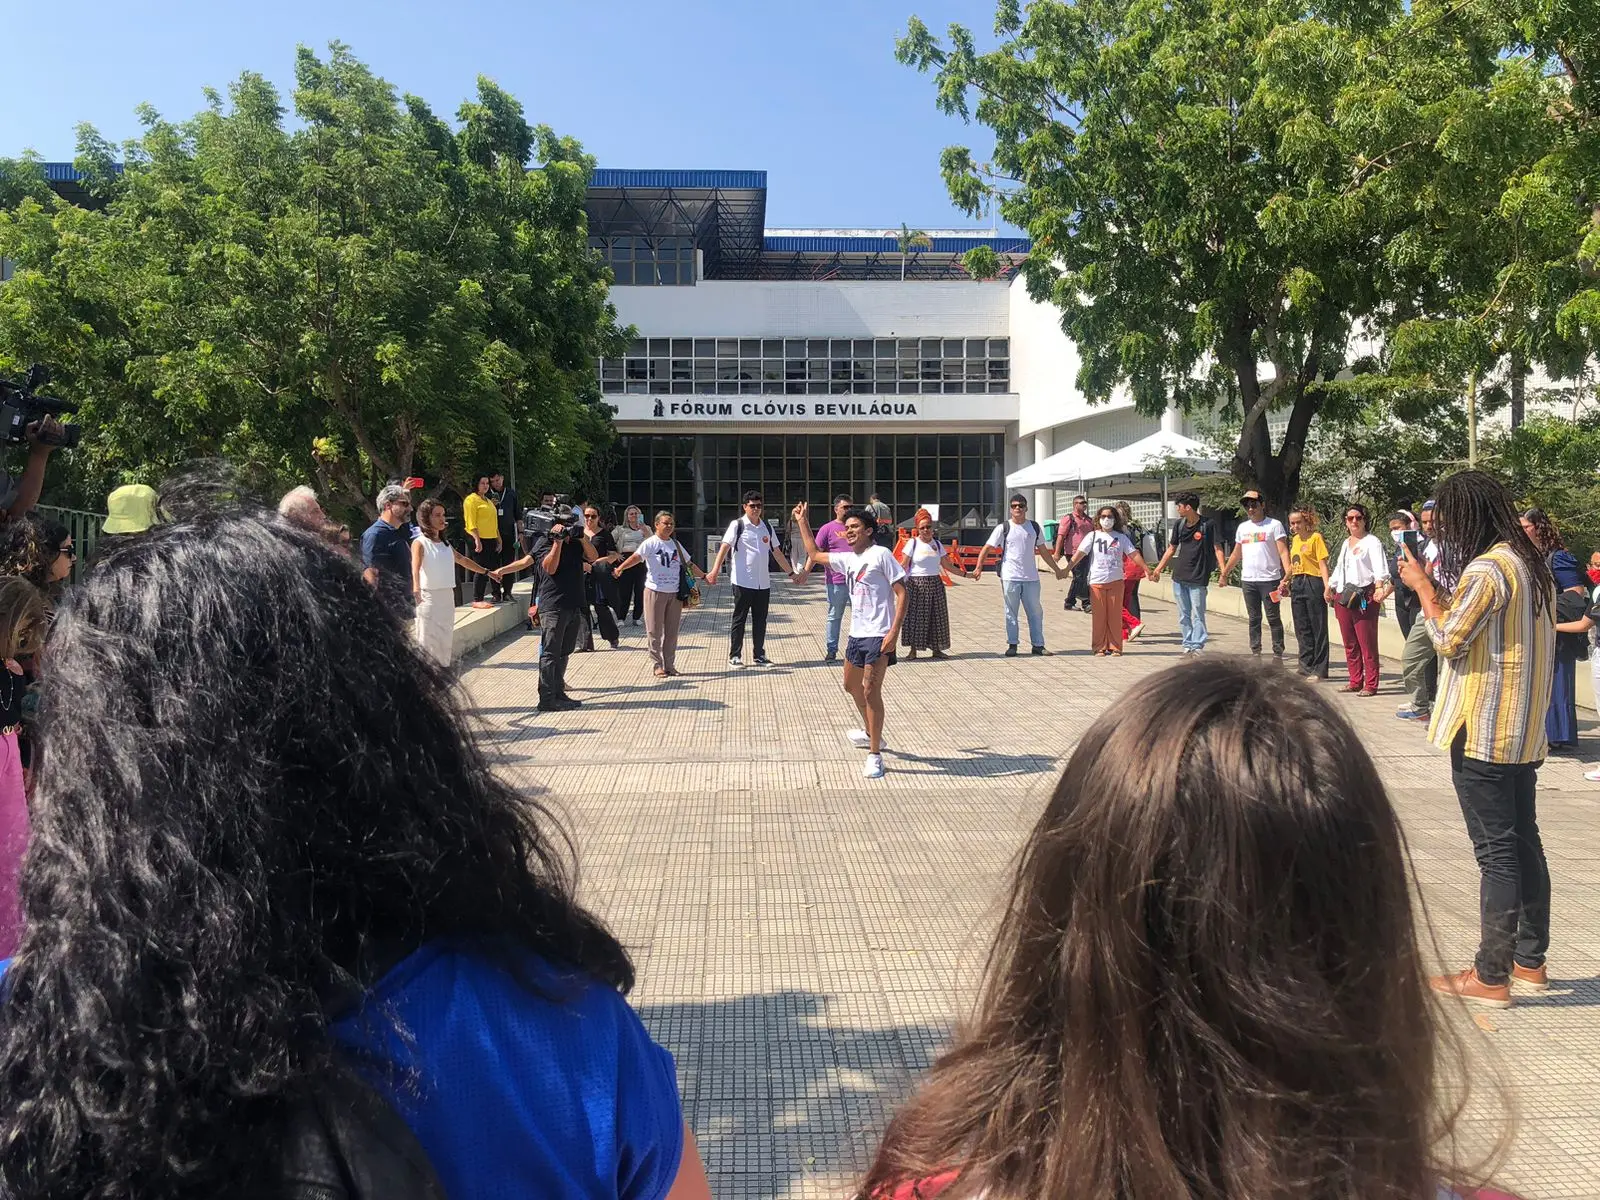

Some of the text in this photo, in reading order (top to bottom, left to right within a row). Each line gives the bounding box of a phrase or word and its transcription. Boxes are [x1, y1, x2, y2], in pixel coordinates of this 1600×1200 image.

[670, 399, 917, 416] FÓRUM CLÓVIS BEVILÁQUA
